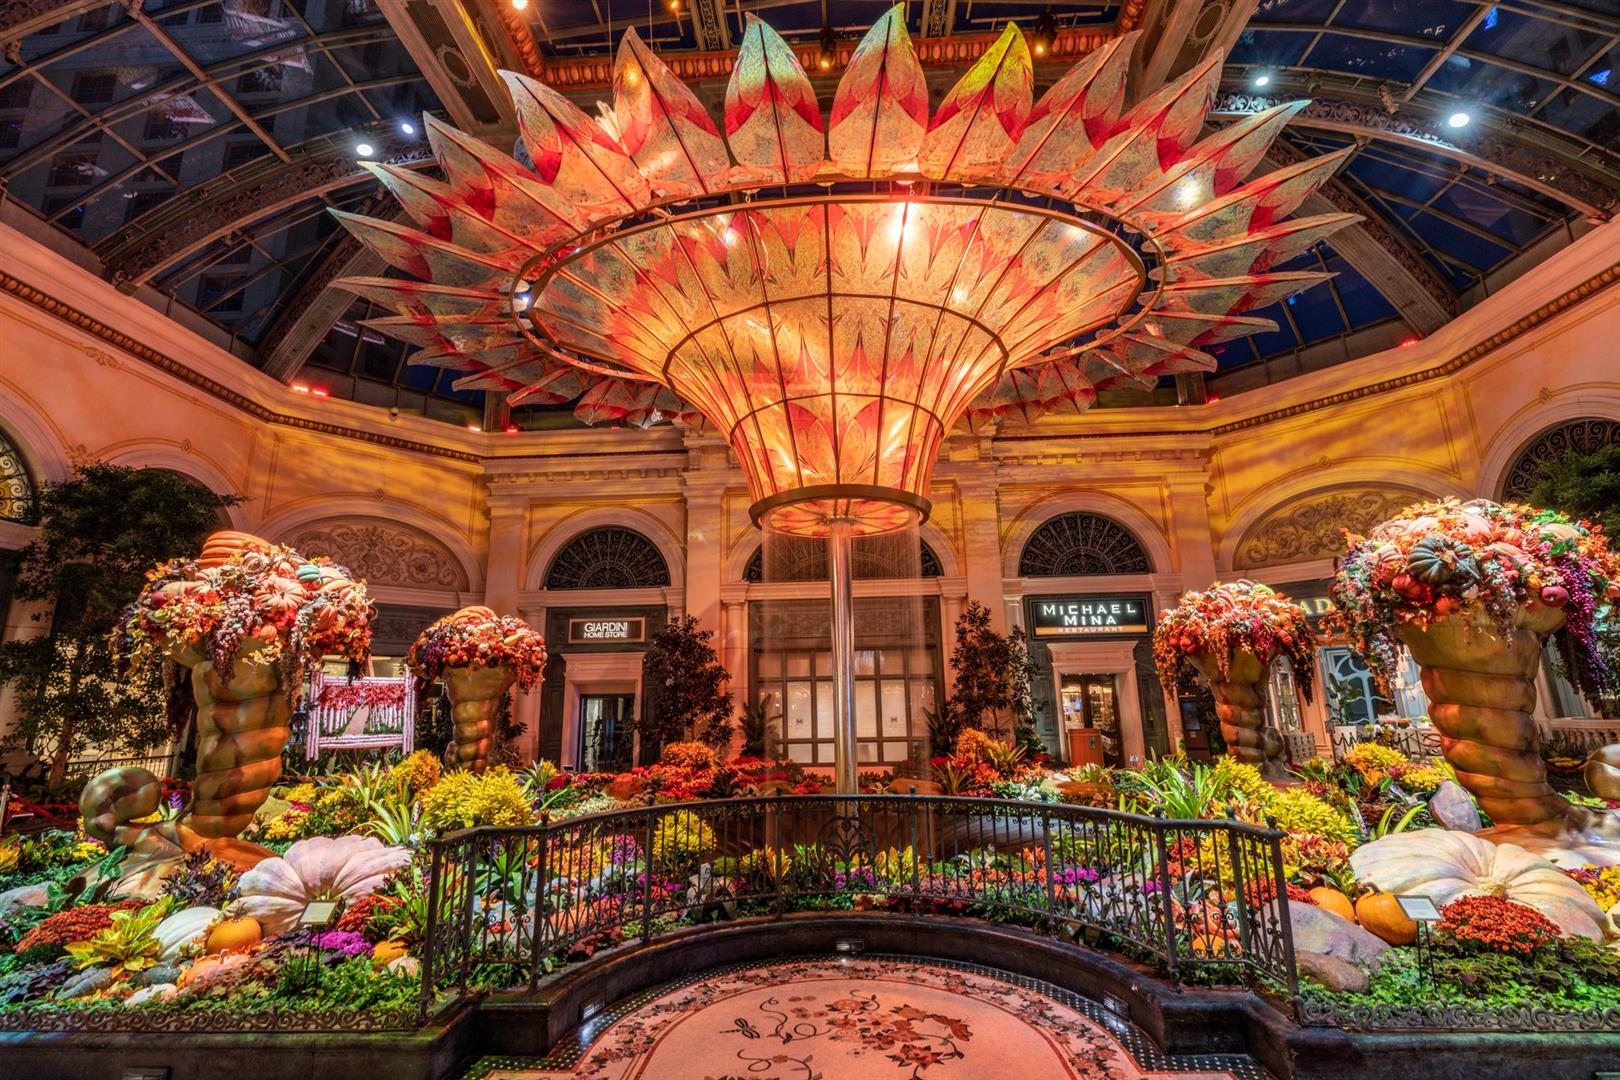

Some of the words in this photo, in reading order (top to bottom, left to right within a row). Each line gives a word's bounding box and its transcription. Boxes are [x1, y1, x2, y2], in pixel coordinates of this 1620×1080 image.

[1043, 604, 1136, 615] MICHAEL
[1064, 615, 1117, 626] MINA
[584, 622, 628, 632] GIARDINI
